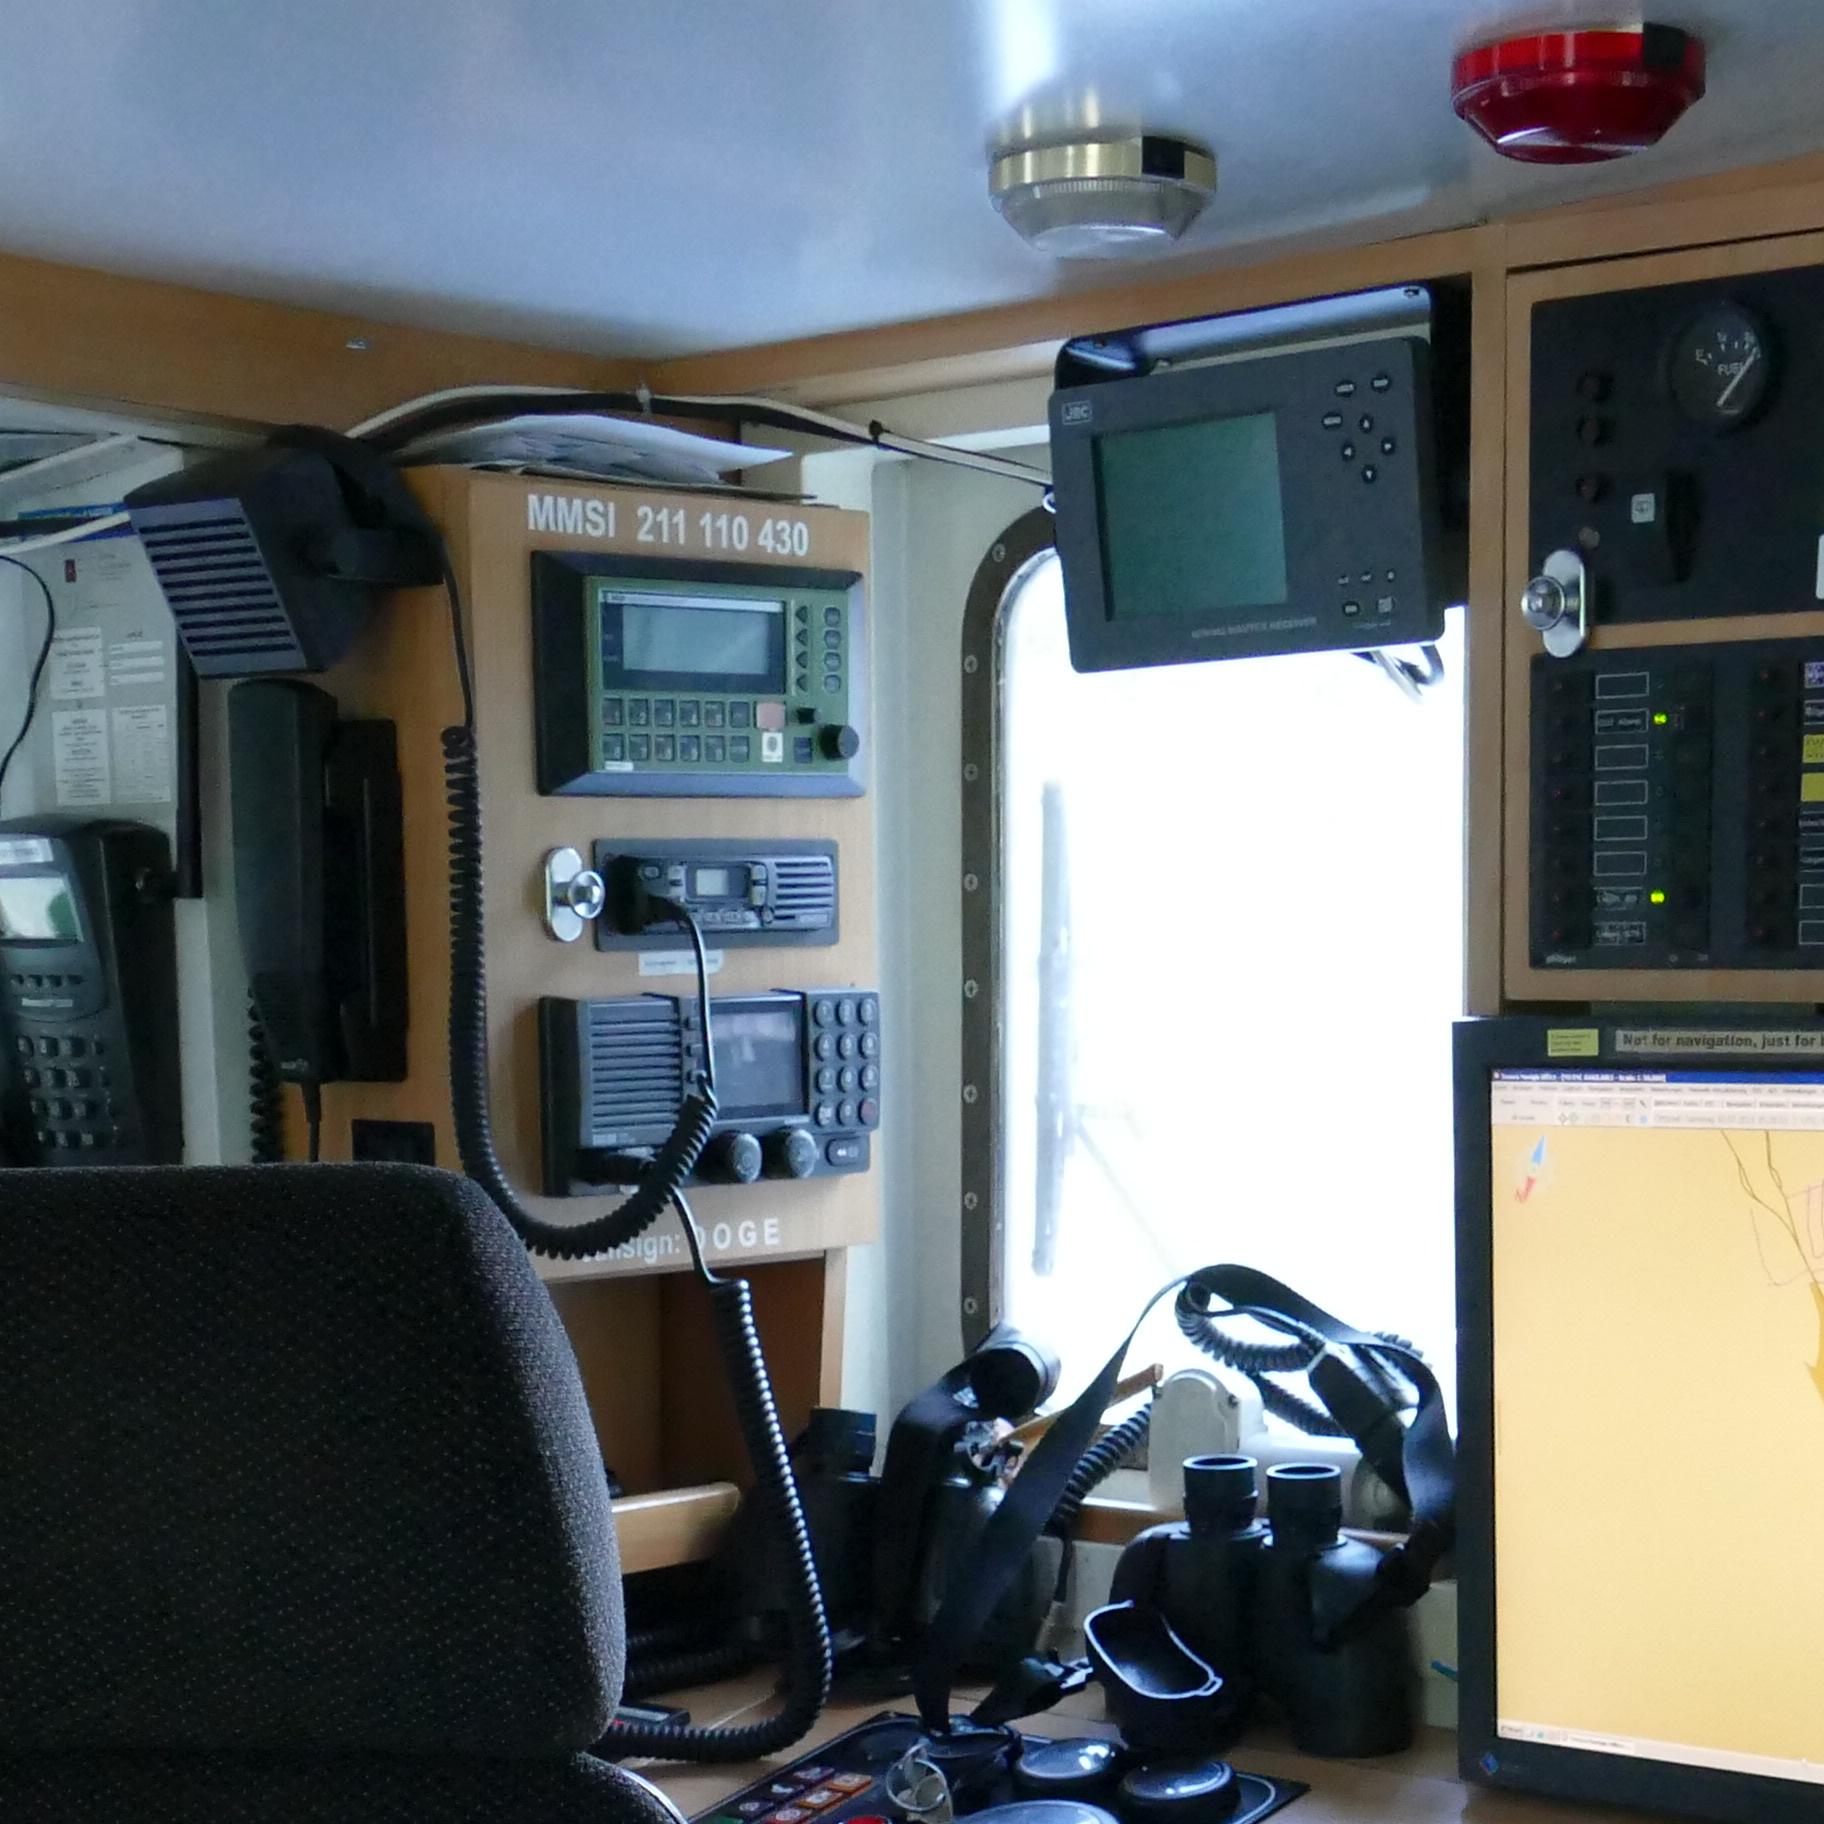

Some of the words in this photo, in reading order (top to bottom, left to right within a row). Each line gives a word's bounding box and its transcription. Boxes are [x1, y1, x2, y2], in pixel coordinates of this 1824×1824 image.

[527, 494, 616, 539] MMSI
[636, 505, 686, 546] 211
[699, 512, 750, 551] 110
[757, 517, 810, 558] 430
[1623, 1033, 1647, 1048] Not
[1652, 1033, 1673, 1047] for
[1676, 1033, 1758, 1051] navigation,
[1760, 1033, 1792, 1051] just
[1795, 1034, 1818, 1048] for
